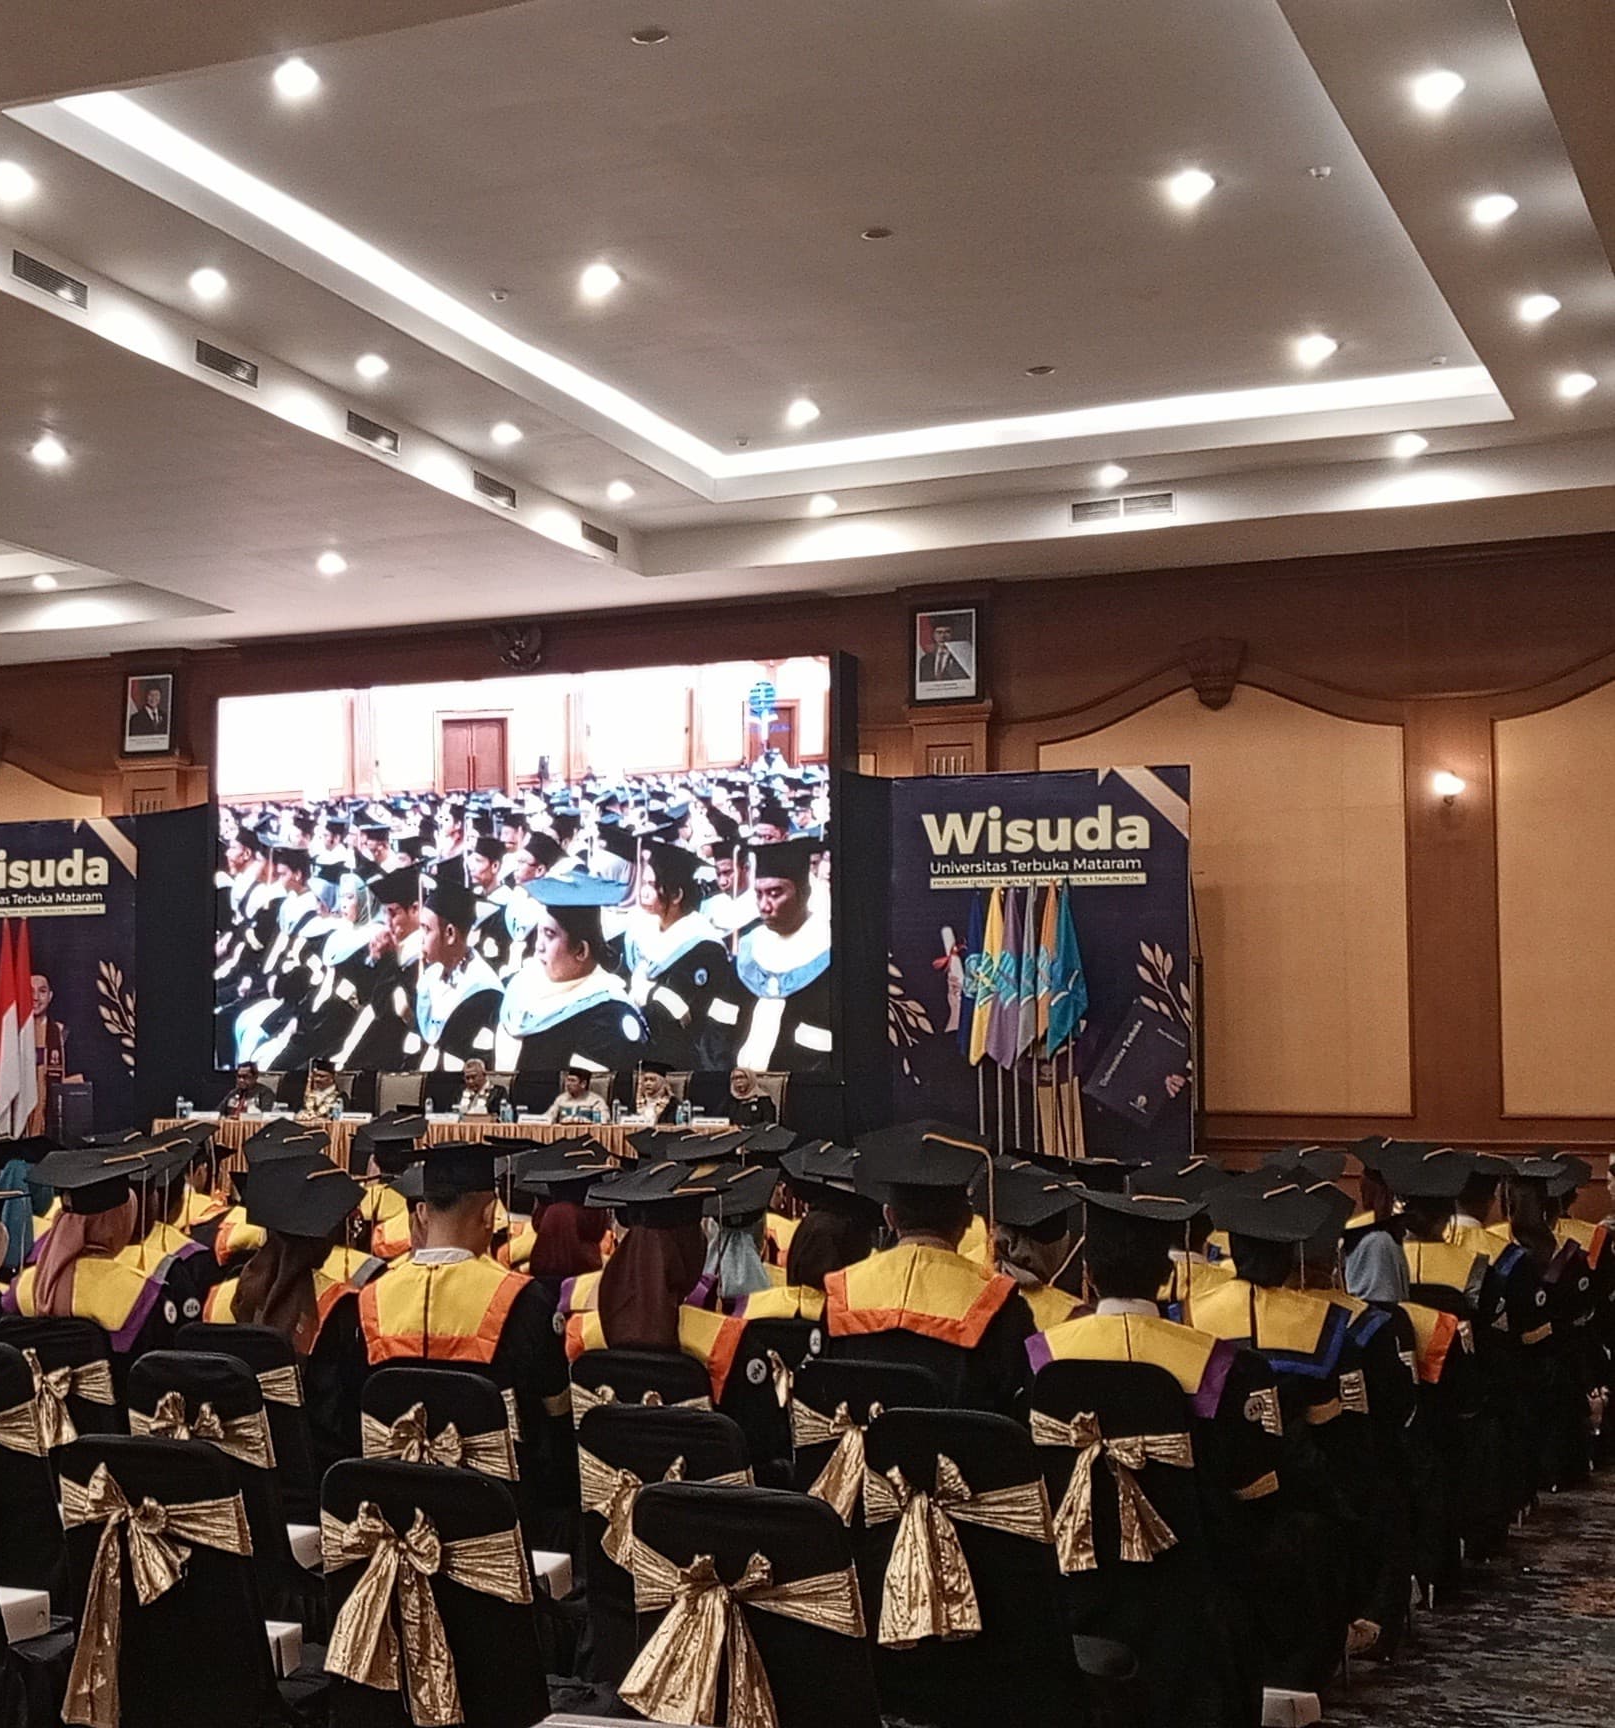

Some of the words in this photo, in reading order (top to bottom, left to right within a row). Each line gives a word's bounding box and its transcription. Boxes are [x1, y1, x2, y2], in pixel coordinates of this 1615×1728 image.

[921, 804, 1151, 855] Wisuda
[929, 860, 1007, 875] Universitas
[1010, 858, 1069, 872] Terbuka
[1073, 857, 1142, 872] Mataram
[12, 892, 53, 905] Terbuka
[55, 891, 103, 903] Mataram
